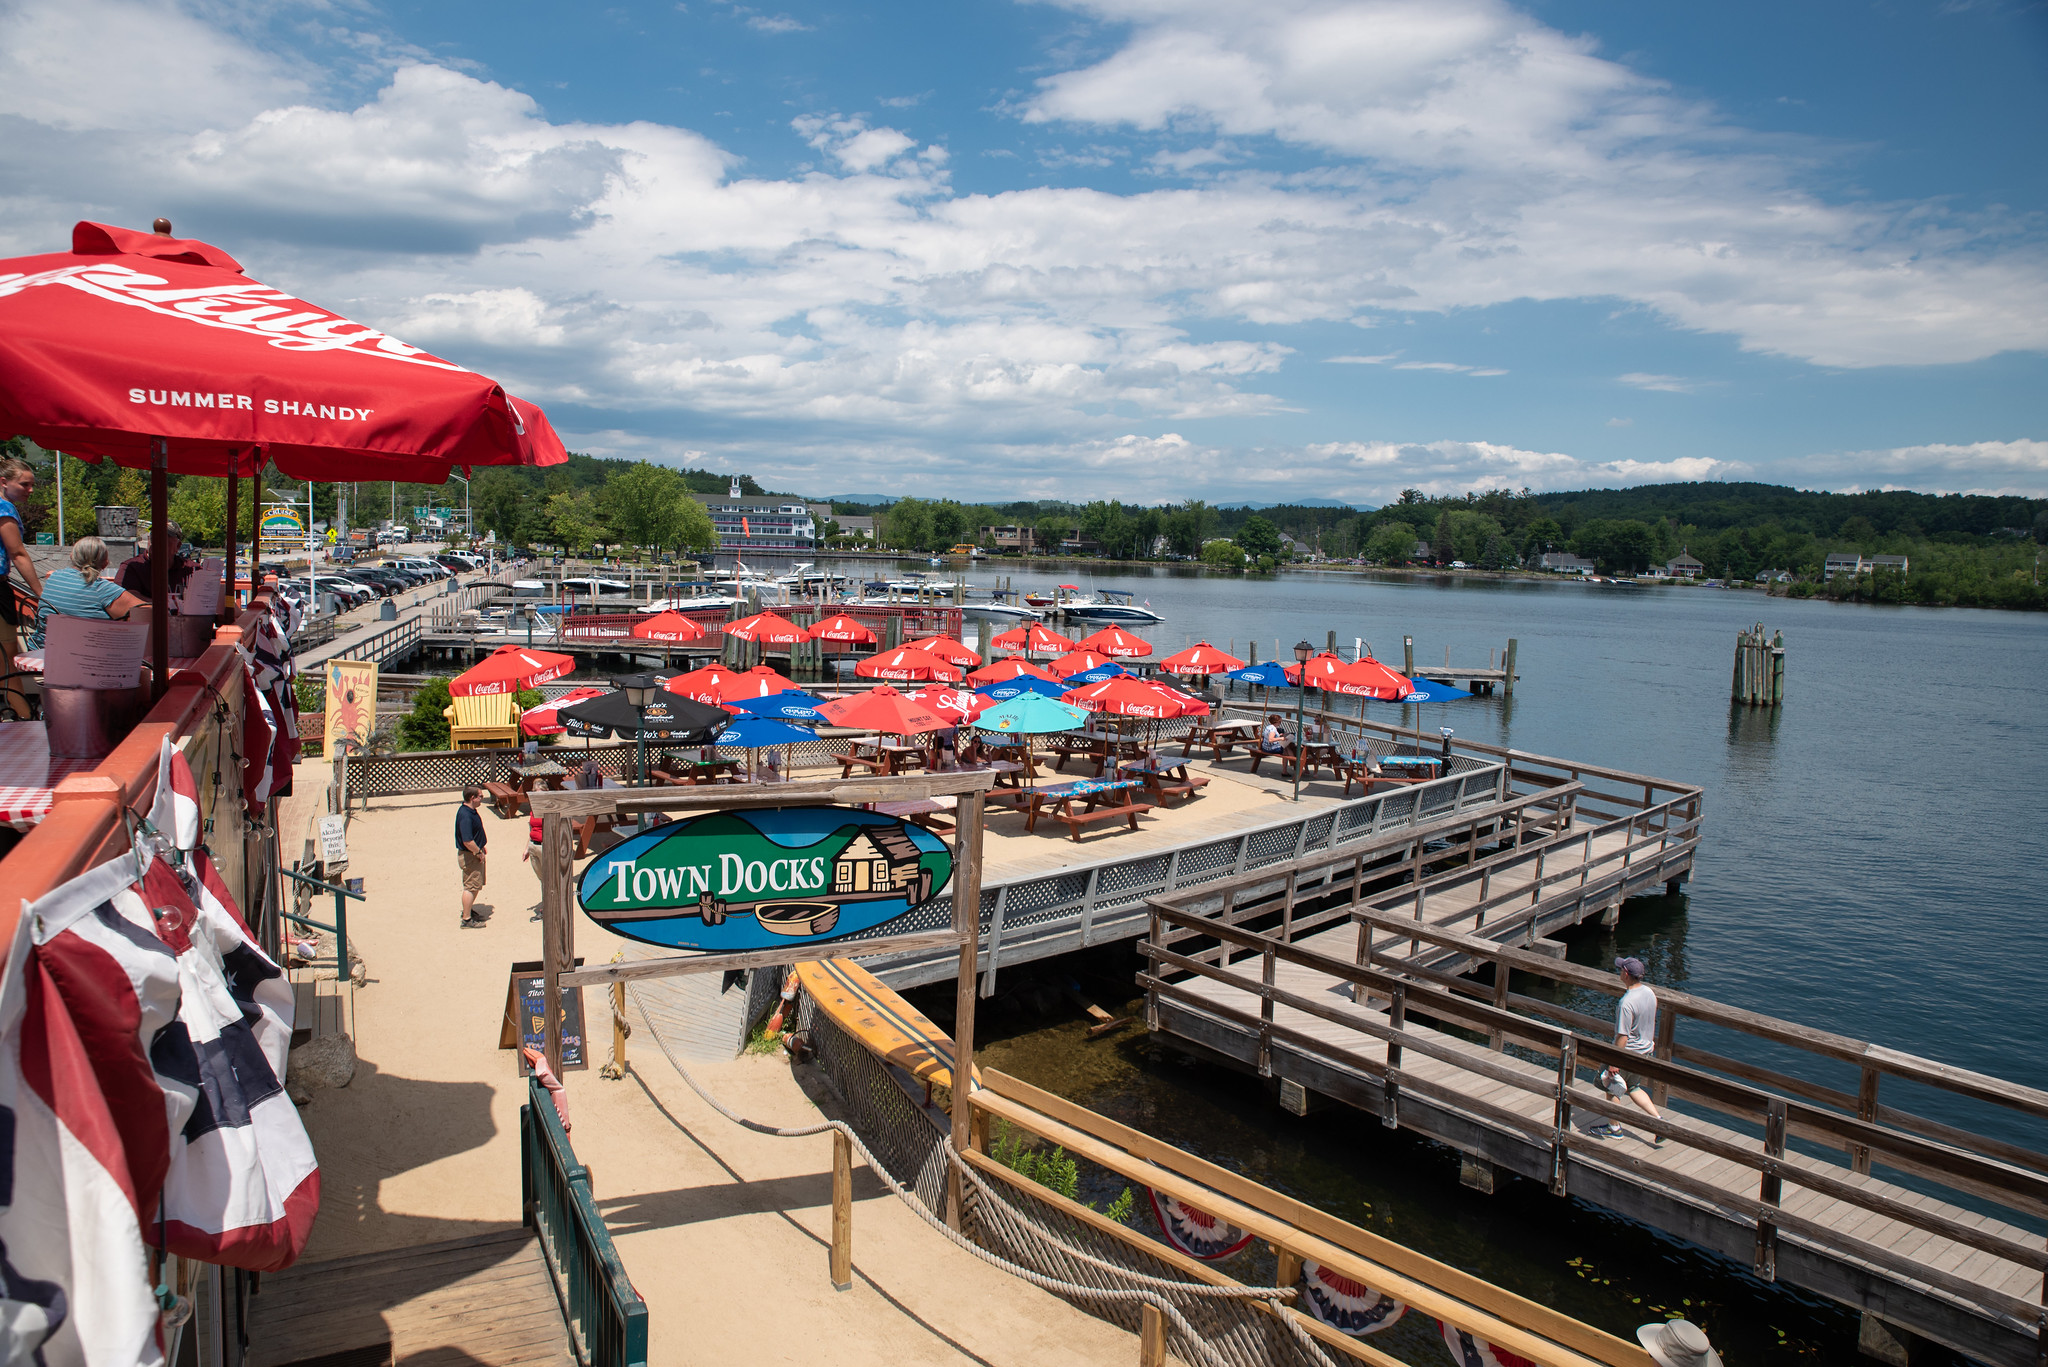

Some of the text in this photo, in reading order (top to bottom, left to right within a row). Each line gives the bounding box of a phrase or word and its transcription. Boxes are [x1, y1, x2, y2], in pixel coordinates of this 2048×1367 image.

[128, 388, 371, 421] SUMMER SHANDY
[1126, 703, 1155, 716] Coca-Cola
[566, 718, 584, 729] Tito's
[322, 835, 343, 843] Beyond
